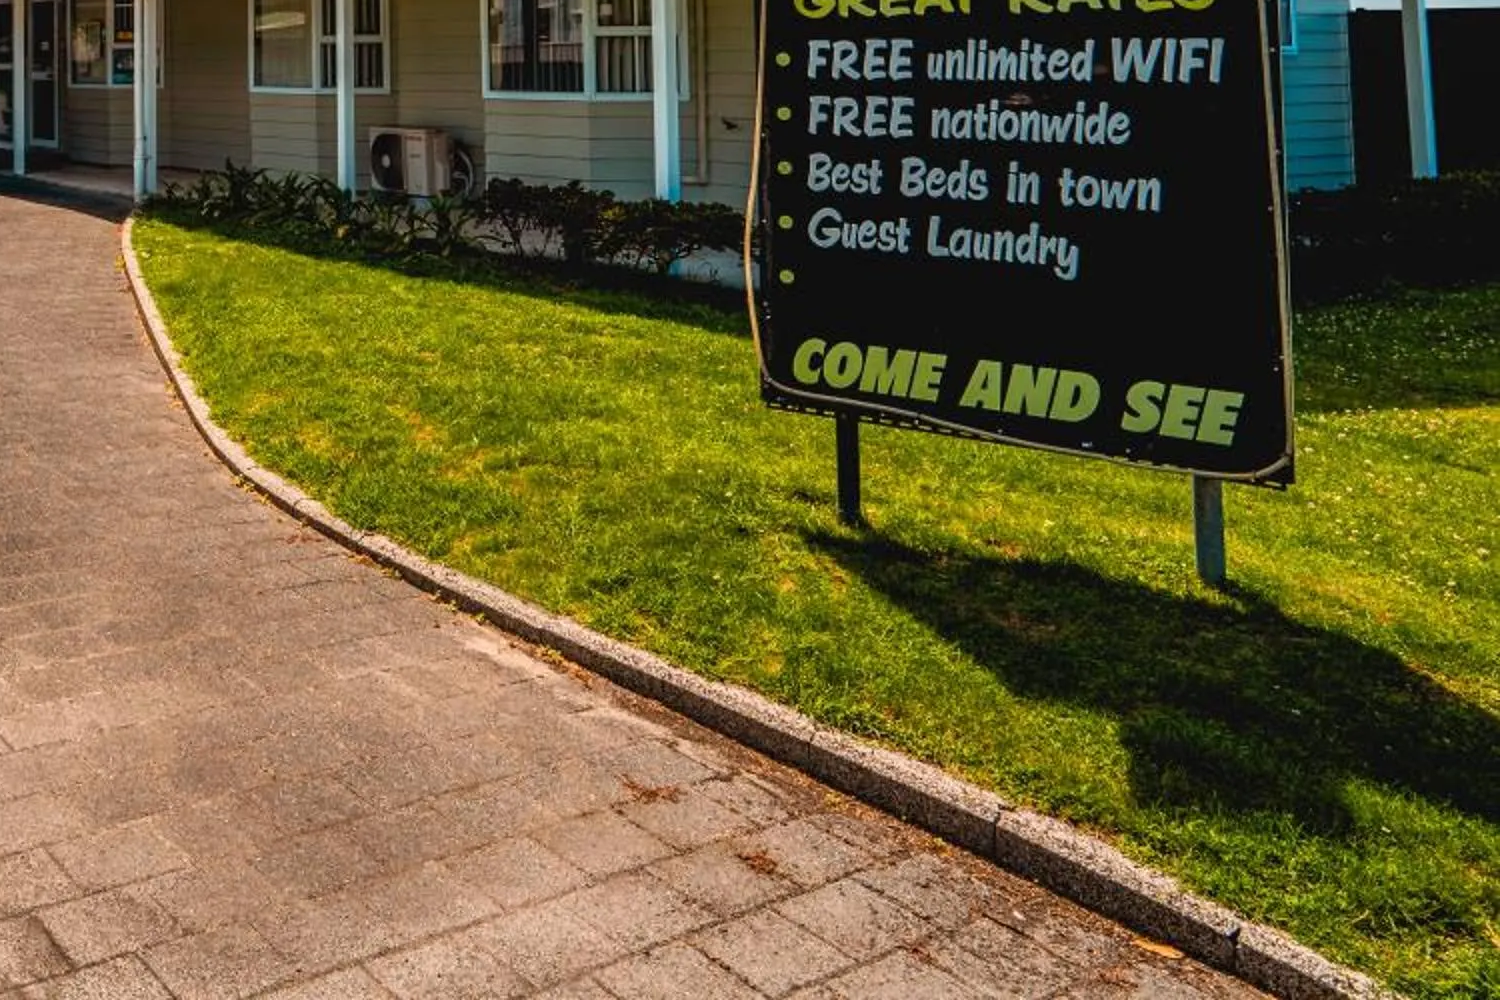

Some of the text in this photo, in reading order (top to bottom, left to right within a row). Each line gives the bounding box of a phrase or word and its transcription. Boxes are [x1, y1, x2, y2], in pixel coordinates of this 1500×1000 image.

[808, 38, 1224, 83] FREE unlimited WIFI
[809, 96, 1130, 144] FREE nationwide
[808, 153, 1160, 211] Best Beds in town
[808, 208, 1078, 280] Guest Laundry
[792, 339, 1244, 445] COME AND SEE
